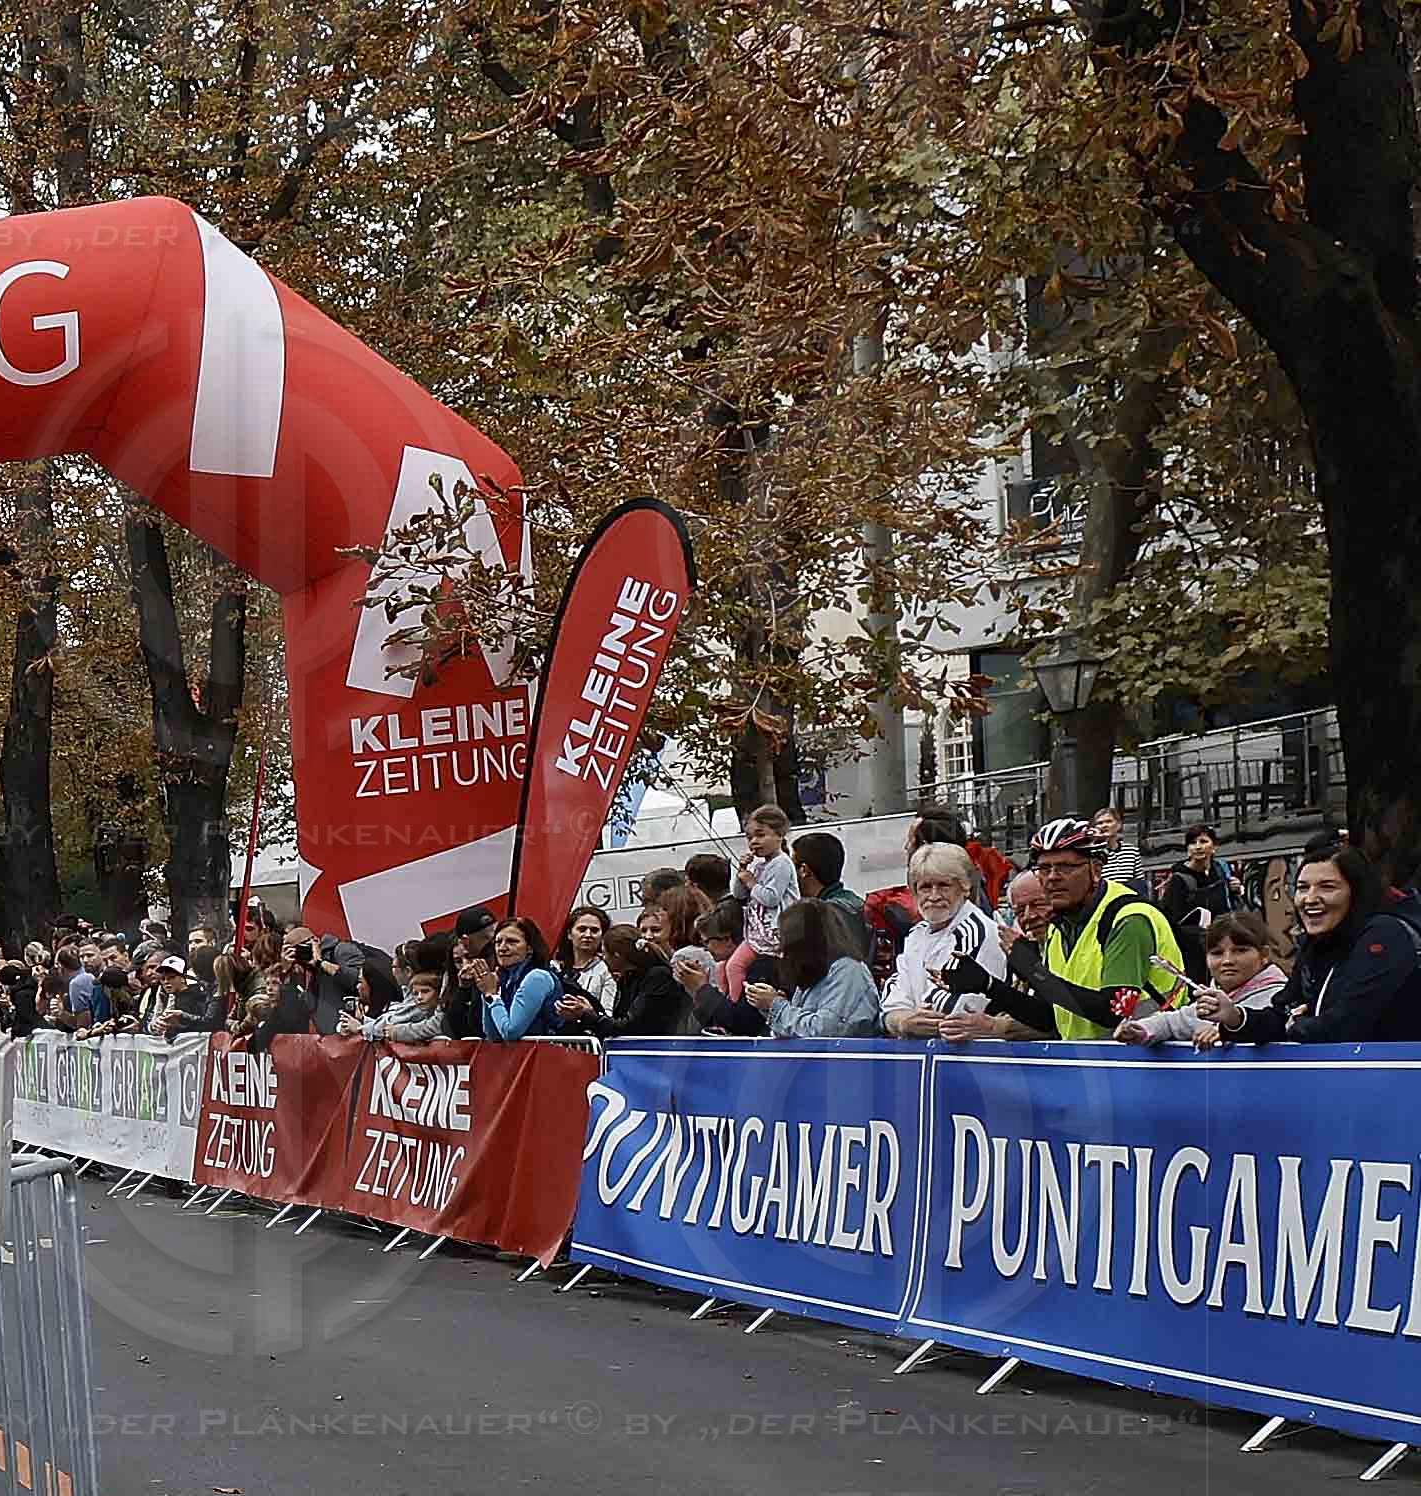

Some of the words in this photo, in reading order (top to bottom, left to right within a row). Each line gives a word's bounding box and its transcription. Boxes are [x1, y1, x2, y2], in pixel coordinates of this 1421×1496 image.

[556, 576, 652, 777] KLEINE
[582, 588, 679, 791] ZEITUNG
[350, 698, 527, 756] KLEINE
[585, 879, 645, 908] GR
[57, 1047, 101, 1110] GRAZ
[111, 1051, 167, 1118] GRAZ
[368, 1055, 472, 1132] KLEINE
[354, 1128, 465, 1213] ZEITUNG
[942, 1112, 1421, 1338] PUNTIGAME
